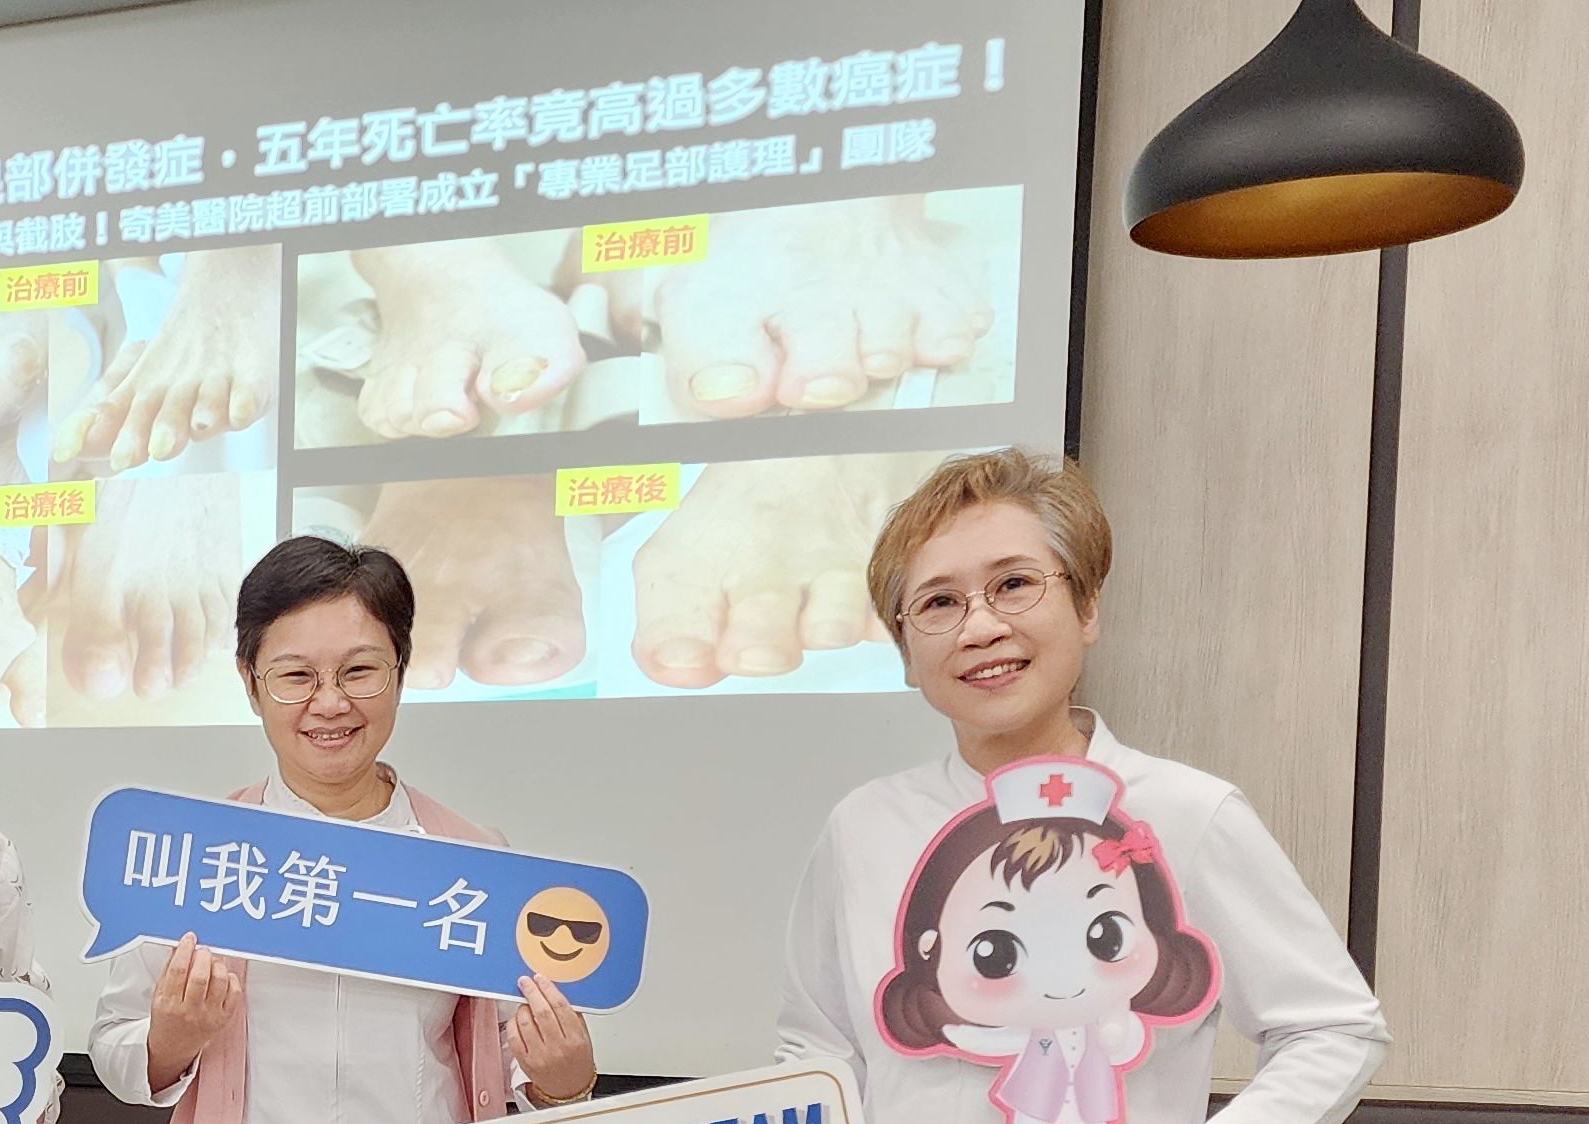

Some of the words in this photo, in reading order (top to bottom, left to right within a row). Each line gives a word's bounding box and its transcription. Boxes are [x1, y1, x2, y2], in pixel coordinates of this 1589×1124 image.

[595, 224, 697, 262] 治療前
[6, 270, 90, 303] 治療前
[4, 489, 85, 521] 治療後
[568, 473, 668, 508] 治療後
[122, 829, 489, 956] 叫我第一名
